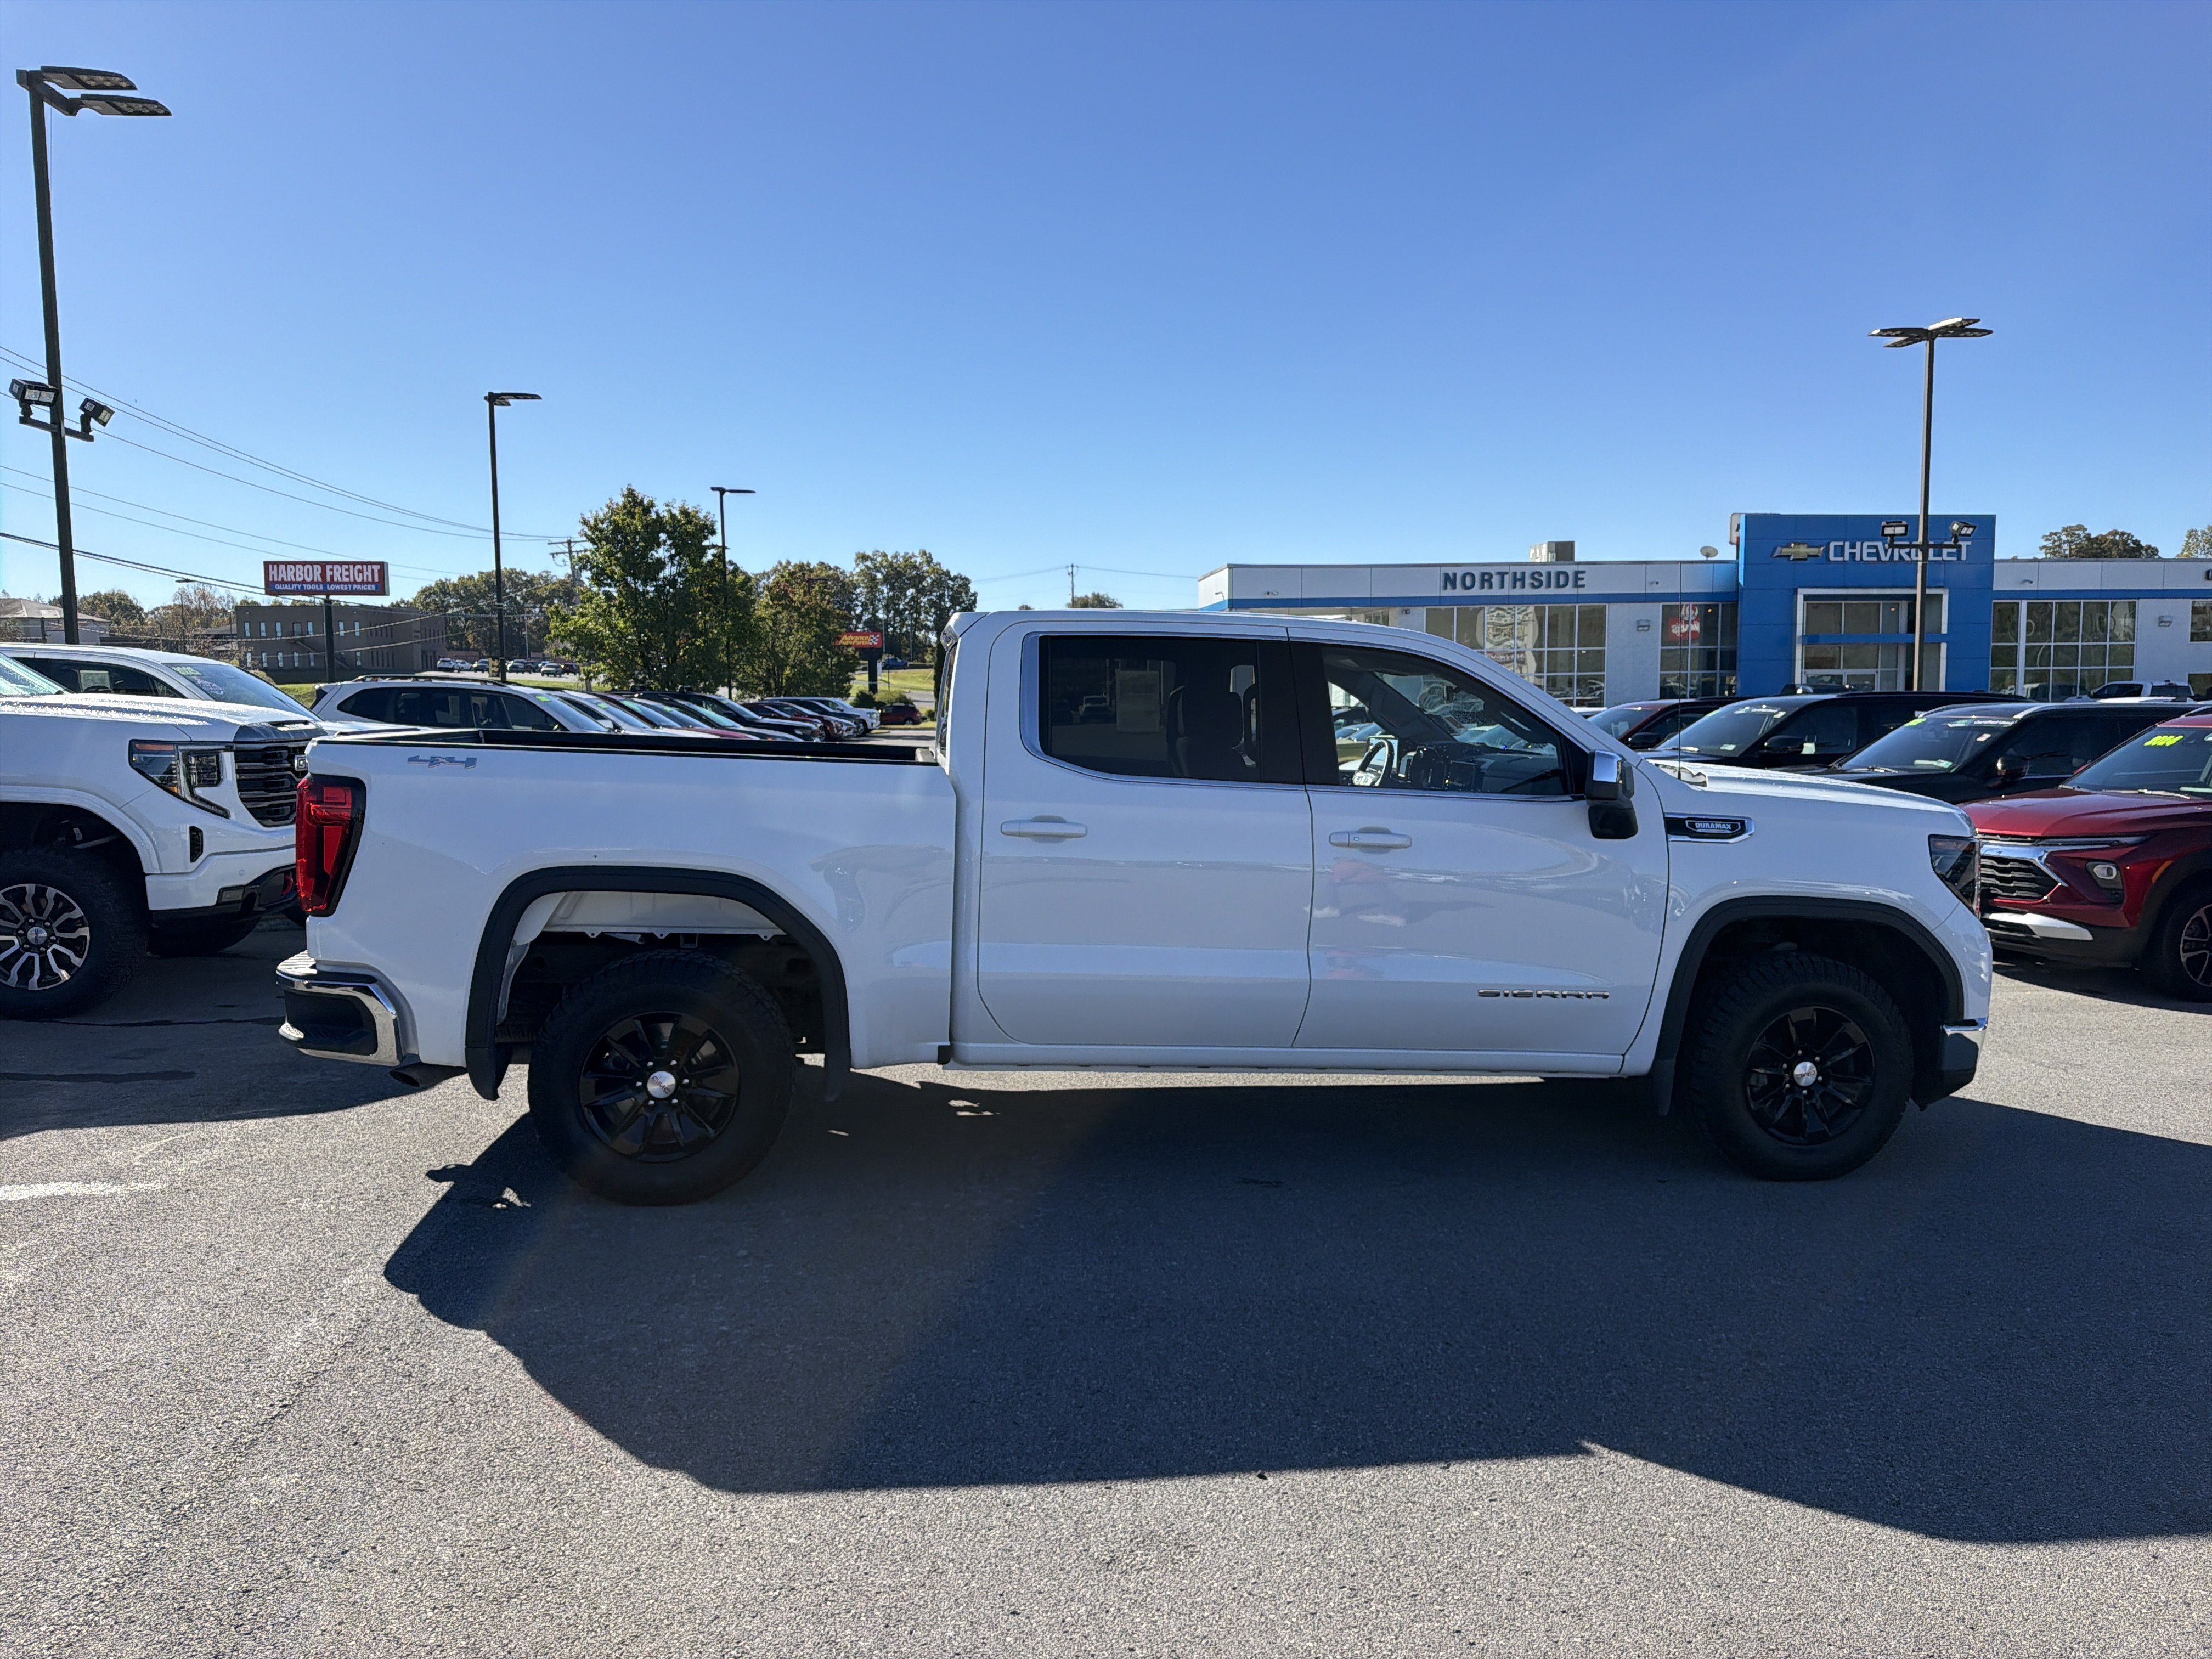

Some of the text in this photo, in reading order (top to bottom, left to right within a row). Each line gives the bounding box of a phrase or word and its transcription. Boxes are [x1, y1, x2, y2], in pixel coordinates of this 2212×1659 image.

[269, 564, 380, 582] HARBOR FREIGHT
[1442, 571, 1586, 590] NORTHSIDE
[1479, 989, 1609, 998] SIERRA
[652, 1075, 671, 1094] GMC
